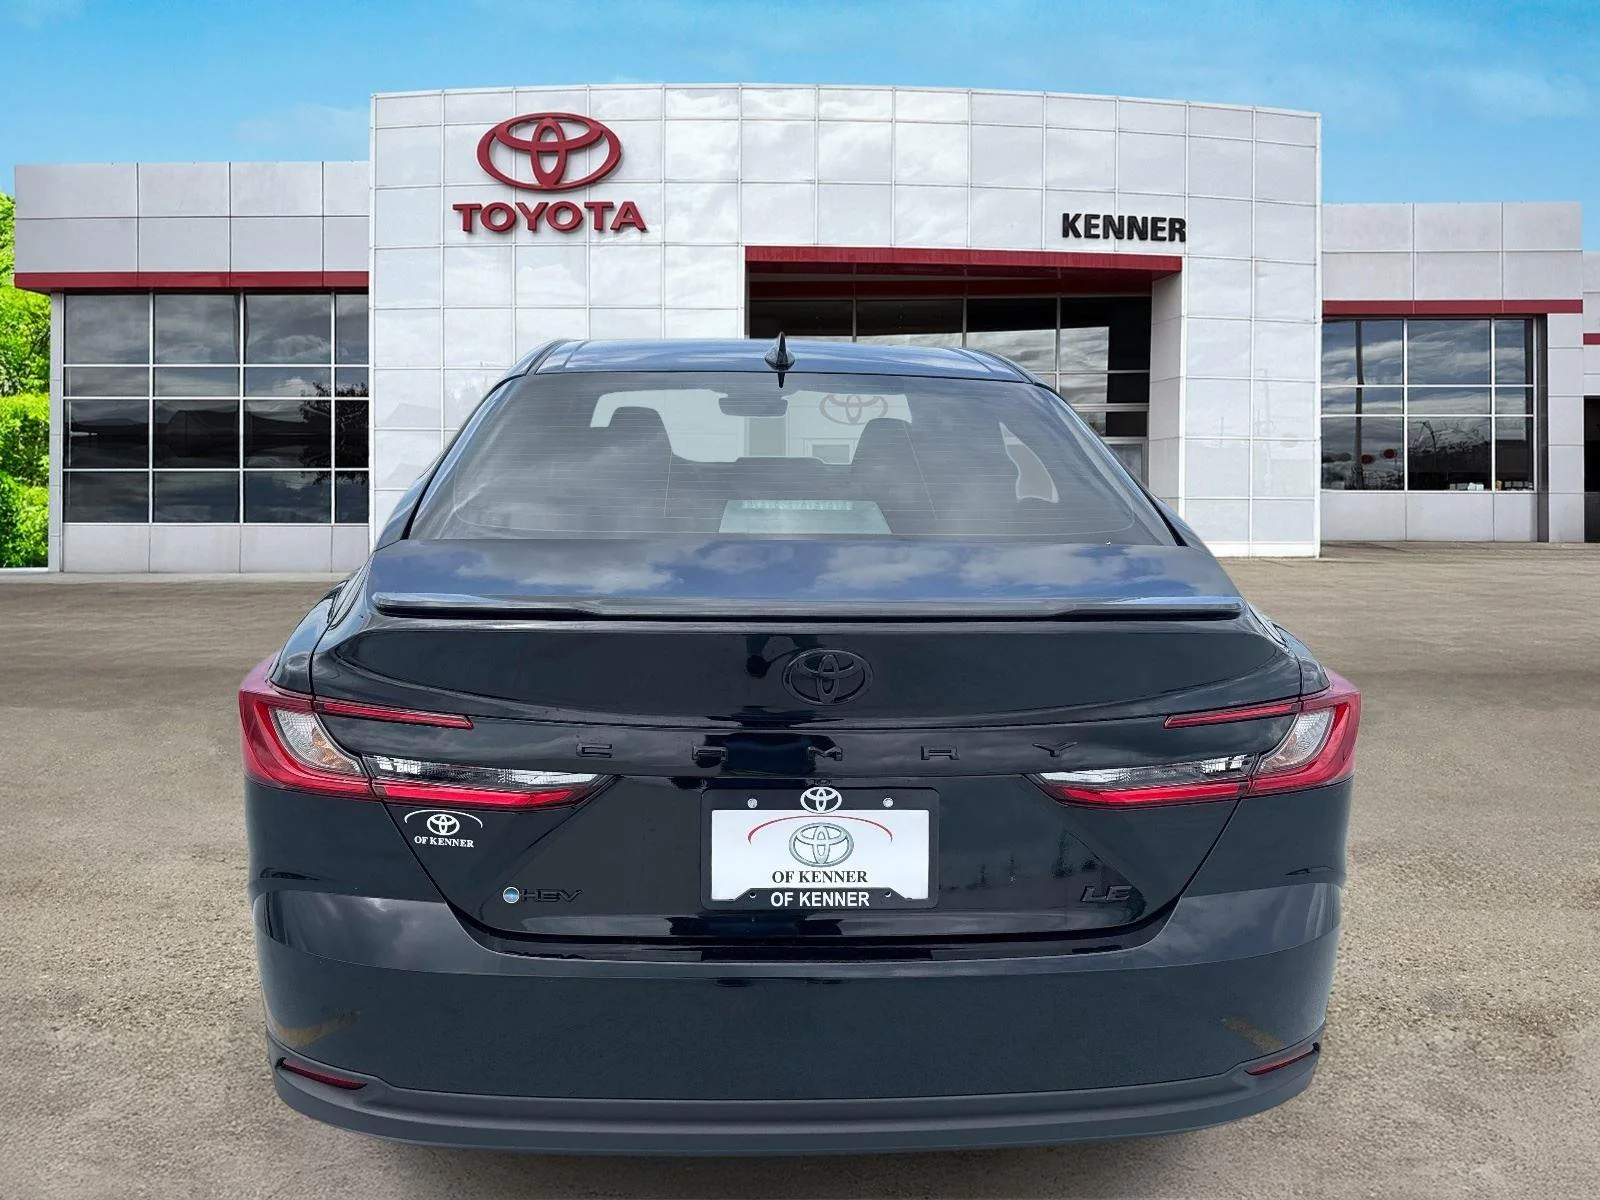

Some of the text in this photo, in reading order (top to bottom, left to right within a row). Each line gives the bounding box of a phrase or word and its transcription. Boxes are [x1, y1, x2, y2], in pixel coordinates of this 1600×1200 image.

[453, 201, 646, 232] TOYOTA
[1062, 213, 1186, 242] KENNER
[414, 836, 474, 848] OF KENNER
[772, 870, 868, 883] OF KENNER
[520, 888, 582, 902] HEV
[770, 891, 870, 907] OF KENNER
[1080, 885, 1132, 902] LE
